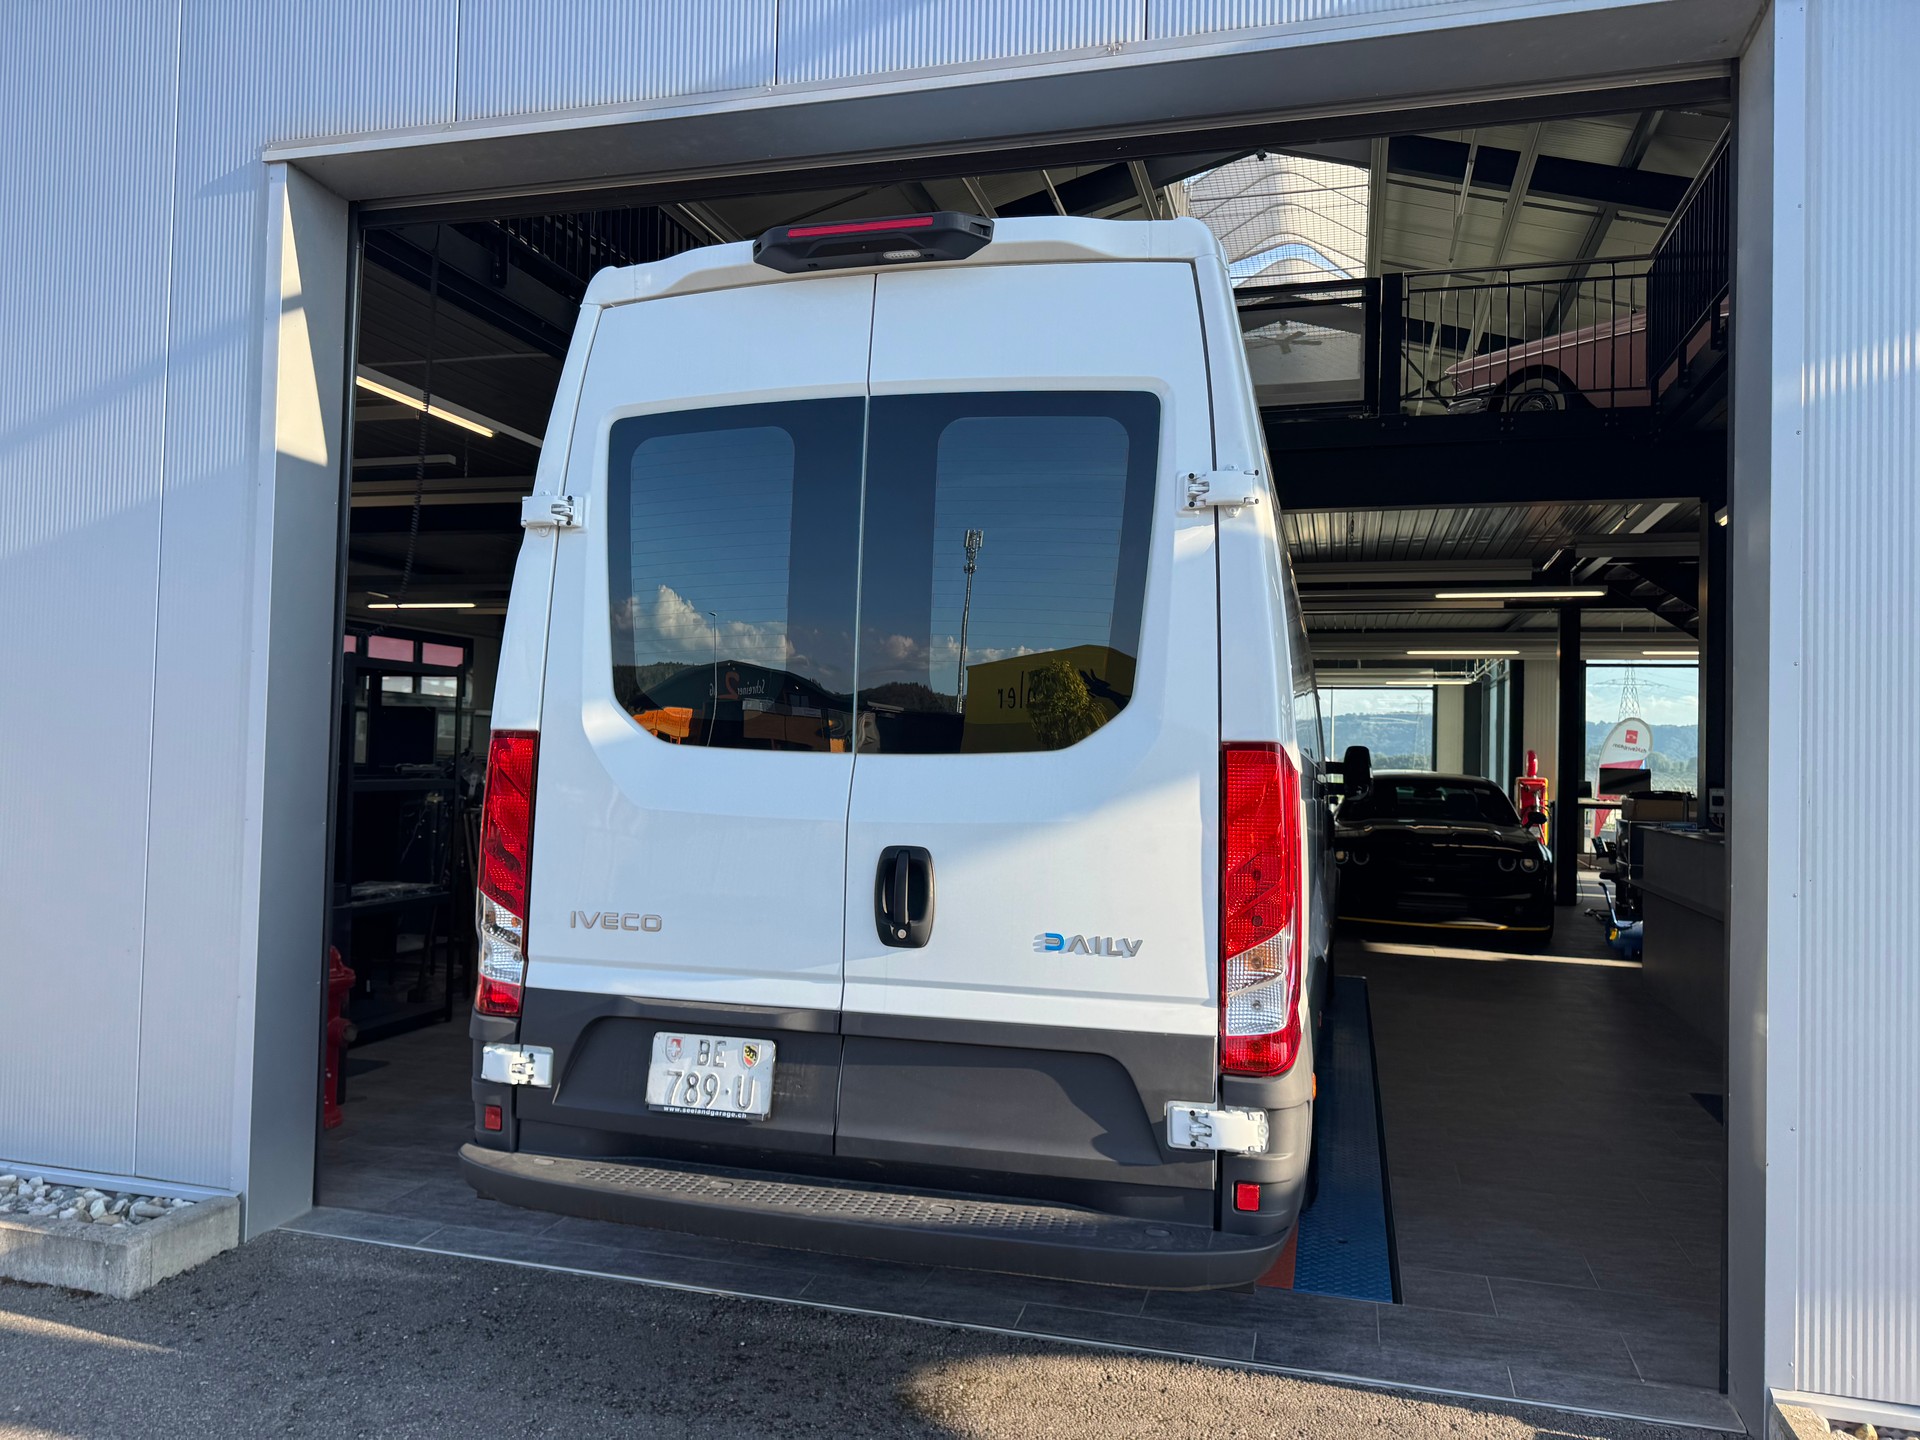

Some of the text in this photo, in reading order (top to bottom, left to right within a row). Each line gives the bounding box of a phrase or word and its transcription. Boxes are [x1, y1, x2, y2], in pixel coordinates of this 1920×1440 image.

[570, 910, 663, 932] IVECO
[696, 1038, 727, 1068] BE
[663, 1105, 748, 1119] www.seelandgarage.ch
